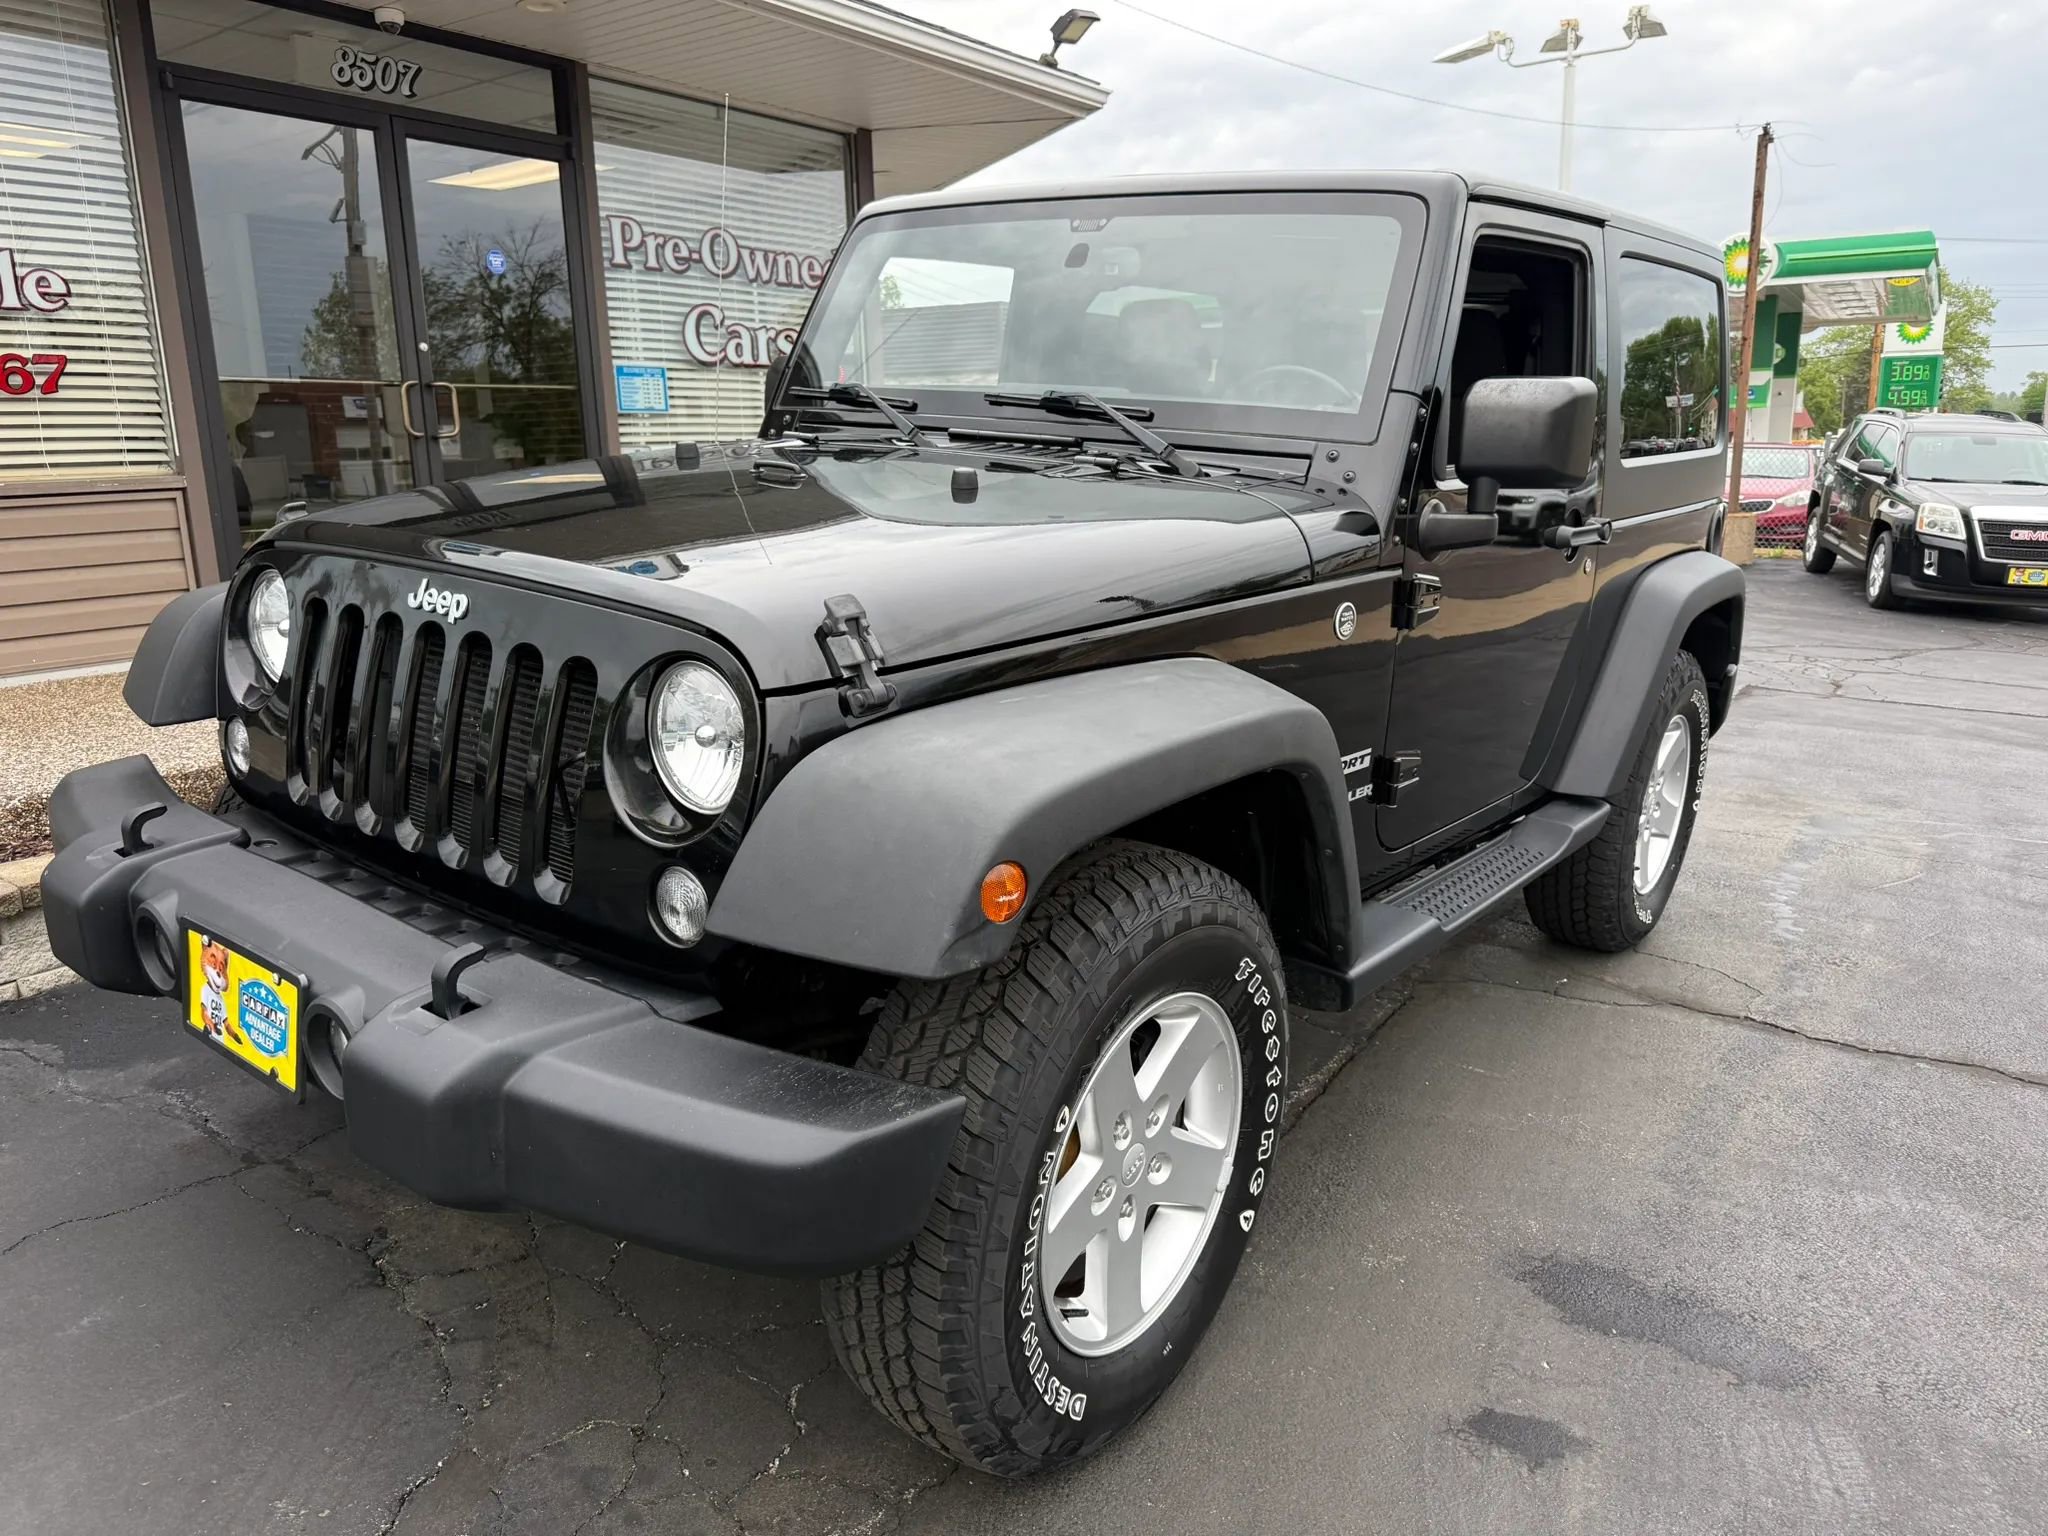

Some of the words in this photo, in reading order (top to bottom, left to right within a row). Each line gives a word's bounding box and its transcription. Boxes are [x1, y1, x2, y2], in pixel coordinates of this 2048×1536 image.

[331, 46, 423, 98] 8507
[606, 214, 838, 290] Pre-Owne
[1890, 365, 1923, 381] 3.89
[1888, 390, 1920, 405] 4.99
[407, 578, 470, 624] Jeep
[1348, 784, 1373, 802] LER
[243, 992, 286, 1030] CARFAX
[245, 1011, 281, 1042] ADVANTAGE
[250, 1027, 275, 1052] DEALER
[1235, 958, 1282, 1196] Firestone
[1020, 1151, 1087, 1421] DESTINATION
